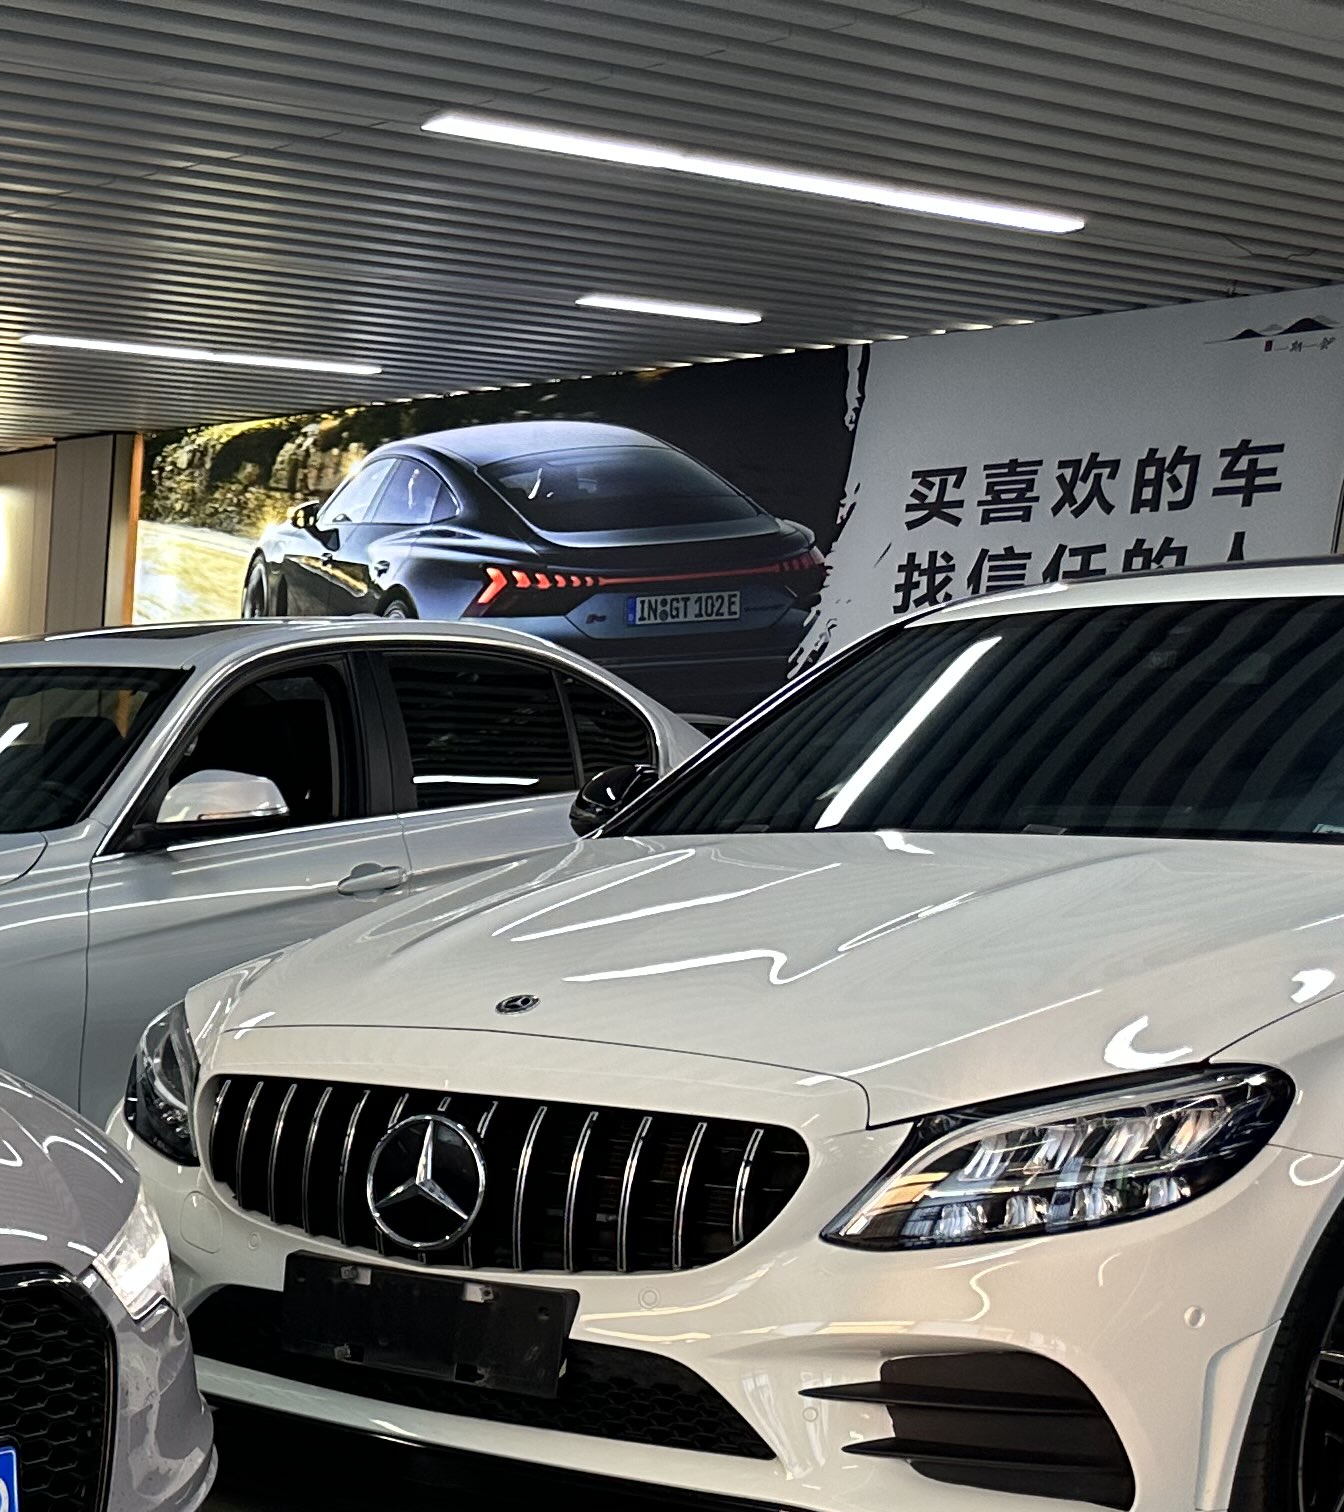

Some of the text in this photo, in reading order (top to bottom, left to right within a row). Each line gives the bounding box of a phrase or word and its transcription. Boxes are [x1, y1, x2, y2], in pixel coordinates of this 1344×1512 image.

[904, 438, 1285, 531] 买喜欢的车
